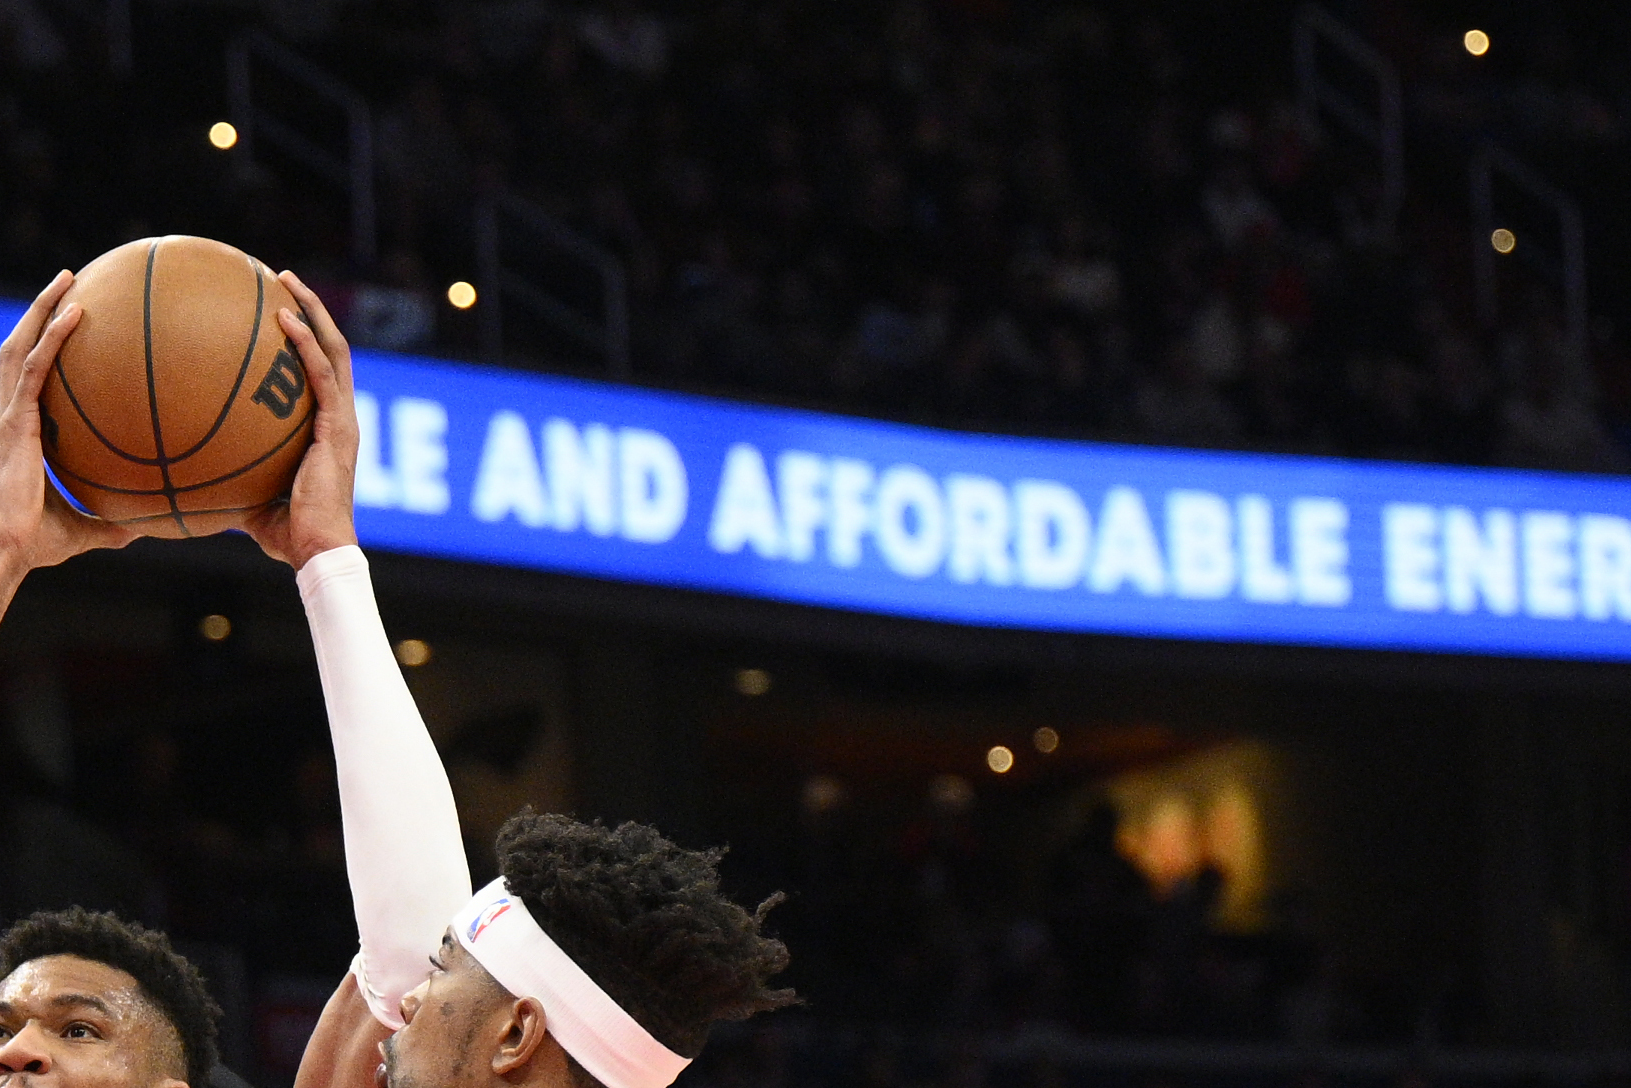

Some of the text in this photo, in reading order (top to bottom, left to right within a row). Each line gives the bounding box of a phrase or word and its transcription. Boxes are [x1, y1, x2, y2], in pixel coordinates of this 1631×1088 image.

[472, 409, 691, 543] AND
[711, 441, 1353, 605] AFFORDABLE
[1384, 505, 1631, 623] ENER
